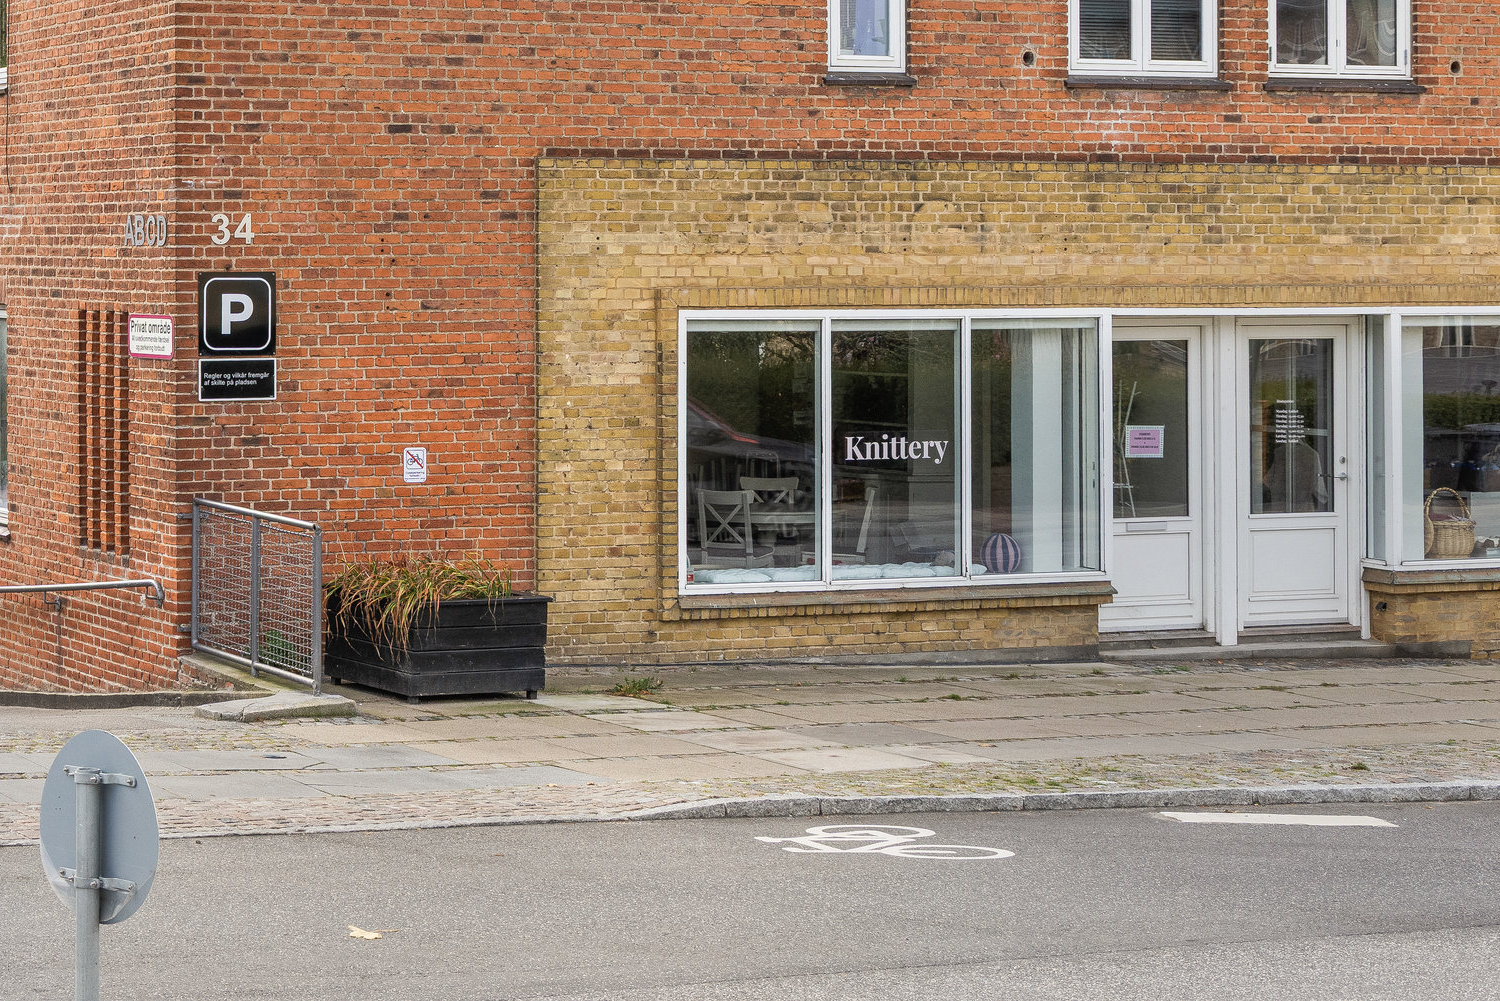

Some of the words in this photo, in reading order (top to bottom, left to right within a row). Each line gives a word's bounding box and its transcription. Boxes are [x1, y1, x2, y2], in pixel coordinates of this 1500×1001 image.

[124, 214, 167, 246] ABCD
[211, 213, 255, 245] 34
[130, 320, 148, 333] Privat
[147, 319, 171, 335] område
[221, 293, 254, 335] P
[203, 372, 223, 380] Regler
[247, 372, 270, 380] fremgår
[226, 379, 234, 387] på
[235, 379, 258, 387] pladsen
[844, 433, 949, 465] Knittery
